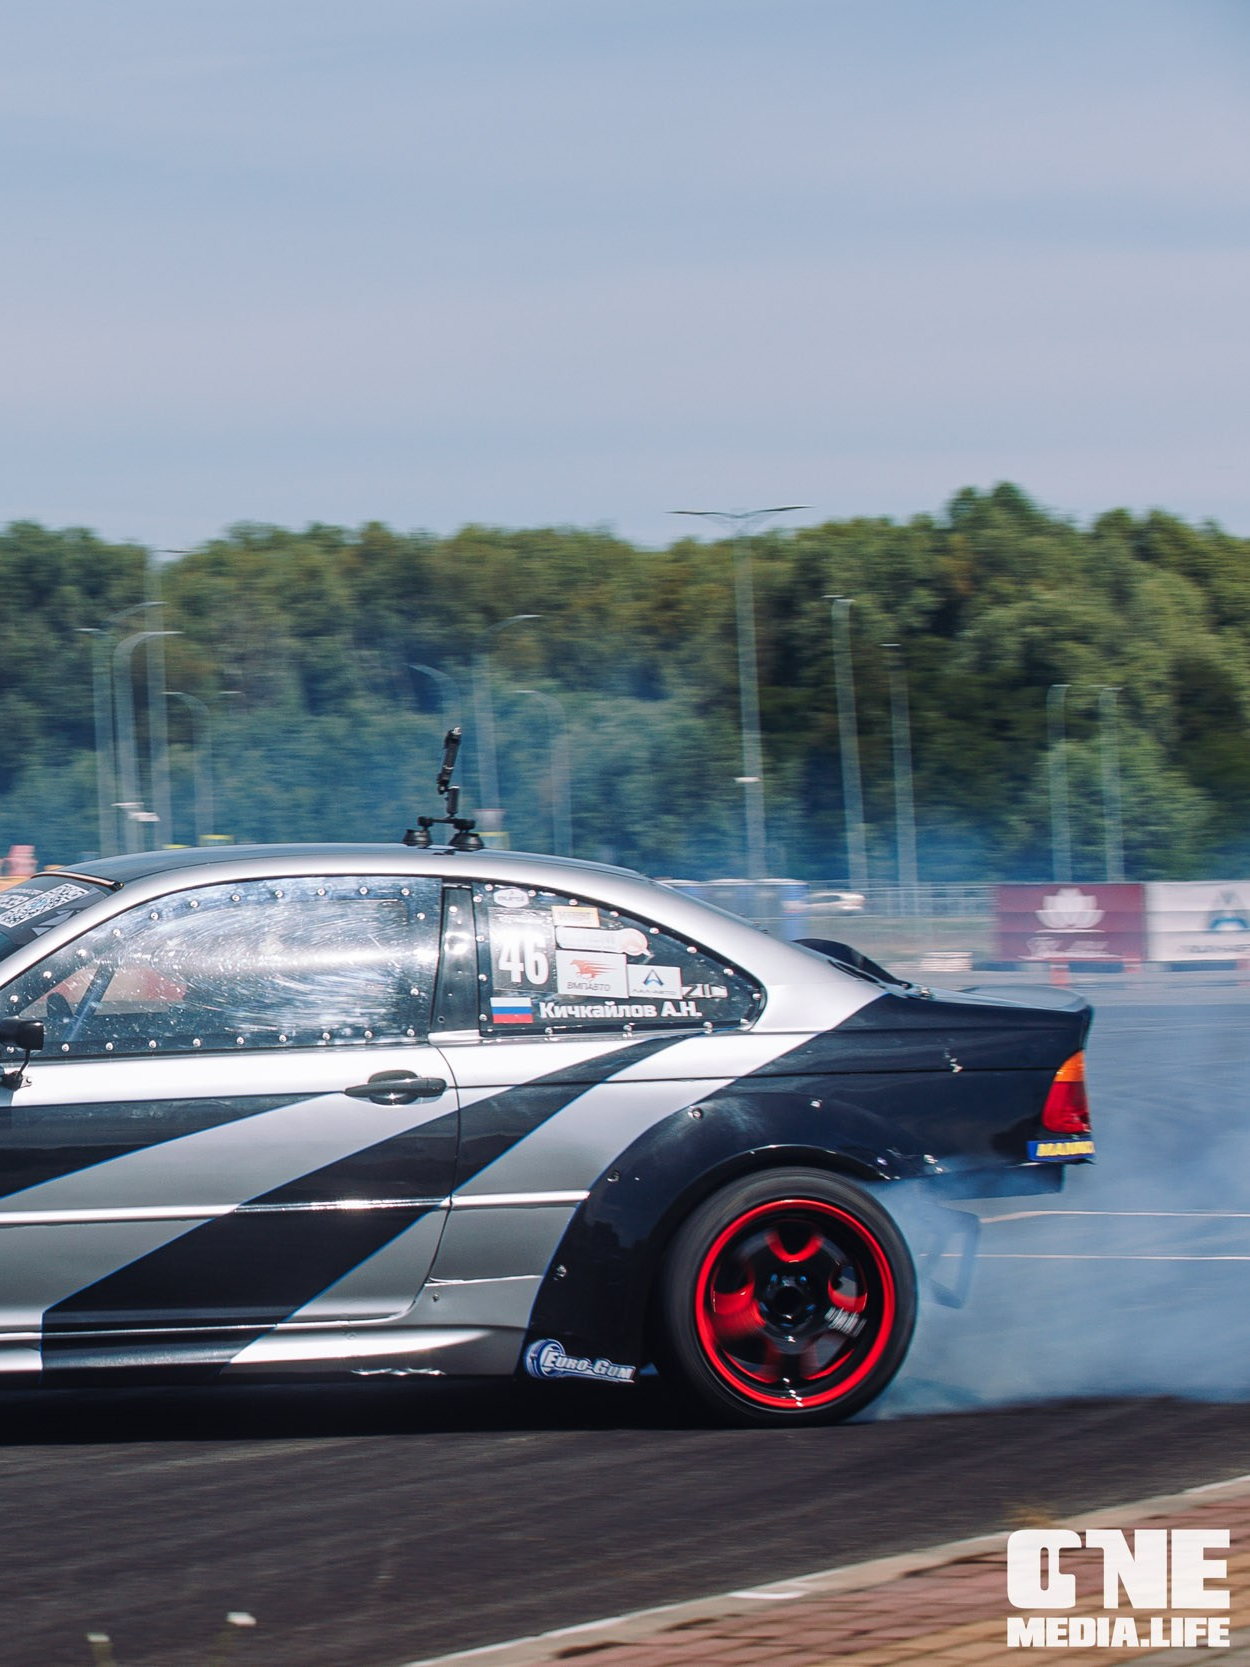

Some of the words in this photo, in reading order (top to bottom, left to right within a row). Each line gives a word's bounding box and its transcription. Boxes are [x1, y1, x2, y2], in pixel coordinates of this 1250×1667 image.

[498, 928, 549, 985] 46
[567, 981, 611, 992] ВМПАВТО
[539, 1001, 657, 1019] Кичкайлов
[661, 1001, 703, 1017] А.Н.
